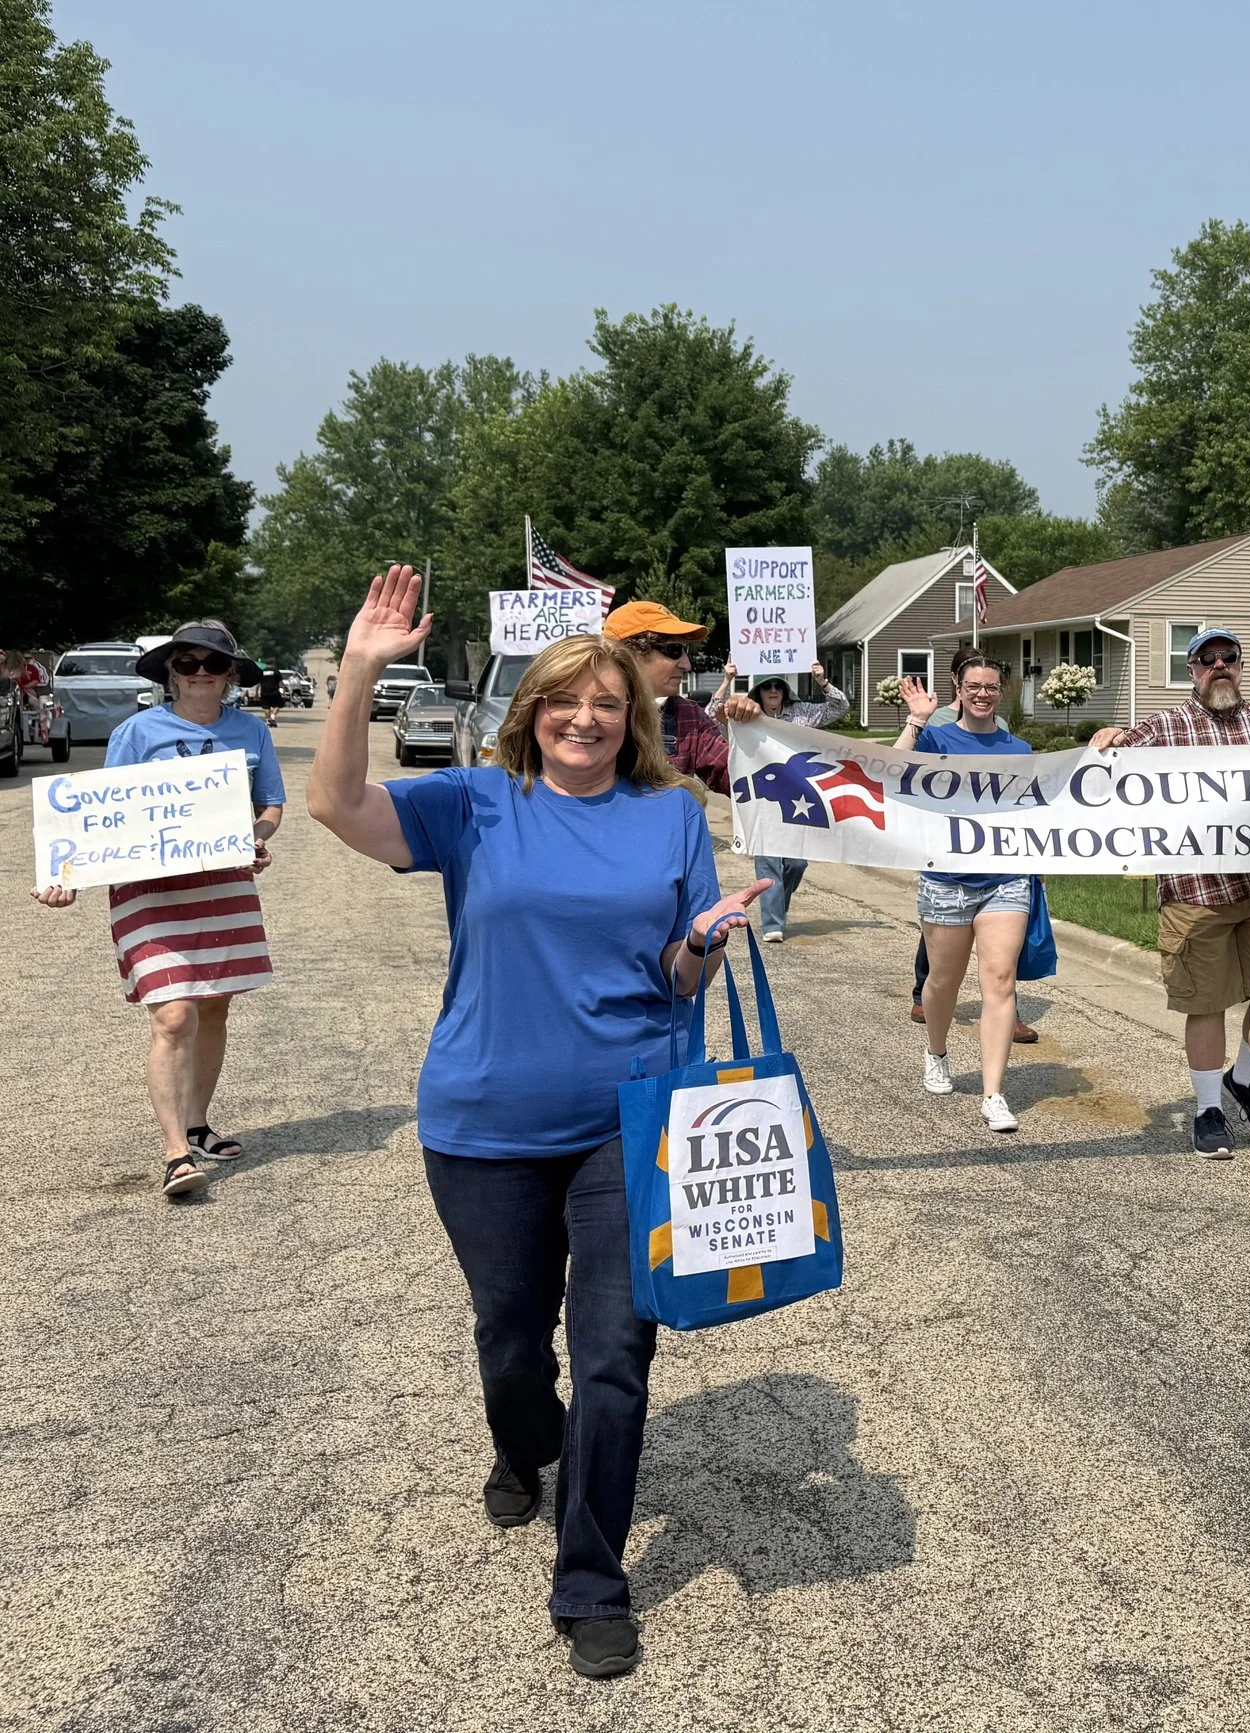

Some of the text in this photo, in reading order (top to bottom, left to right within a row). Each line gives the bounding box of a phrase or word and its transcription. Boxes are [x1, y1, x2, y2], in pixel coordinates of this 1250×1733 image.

[732, 557, 808, 579] SUPPORT
[499, 591, 596, 610] FARMERS
[734, 583, 810, 602] FARMERS:
[532, 606, 574, 623] ARE
[746, 606, 786, 624] OUR
[738, 627, 808, 645] SAFETY
[759, 648, 797, 663] NET
[47, 763, 237, 814] Government
[894, 760, 1051, 807] IOWA
[83, 803, 196, 832] FOR THE
[48, 838, 148, 877] PEOPLE
[686, 1124, 794, 1174] LISA
[682, 1168, 796, 1210] WHITE
[731, 1204, 753, 1215] FOR
[688, 1209, 795, 1239] WISCONSIN
[709, 1229, 777, 1252] SENATE
